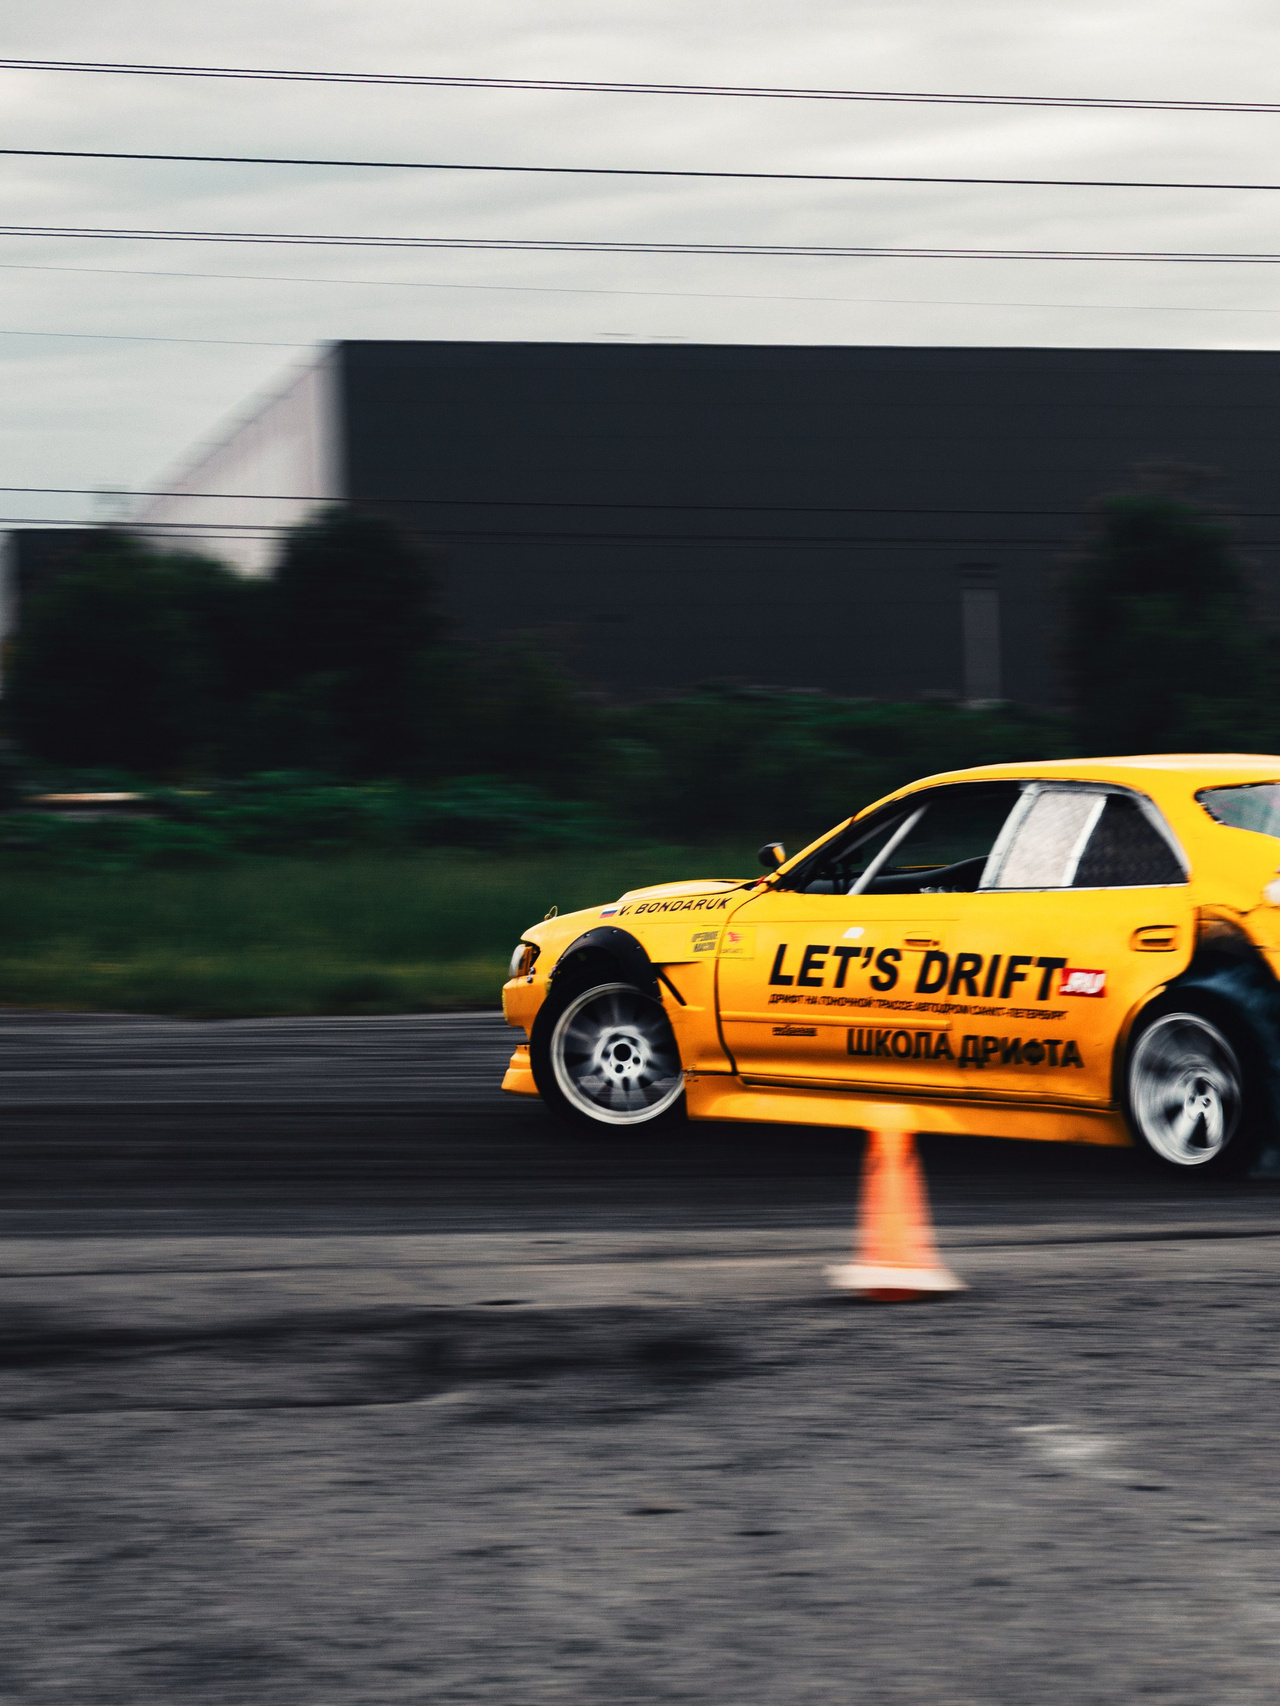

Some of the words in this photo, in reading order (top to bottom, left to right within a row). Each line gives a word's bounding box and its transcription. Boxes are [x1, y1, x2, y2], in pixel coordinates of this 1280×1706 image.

[618, 905, 632, 917] V.
[634, 897, 733, 915] BONDARUK
[768, 943, 902, 992] LET'S
[914, 950, 1069, 1001] DRIFT
[847, 1027, 955, 1060] ШКОЛА
[958, 1034, 1085, 1069] ДРИФТА
